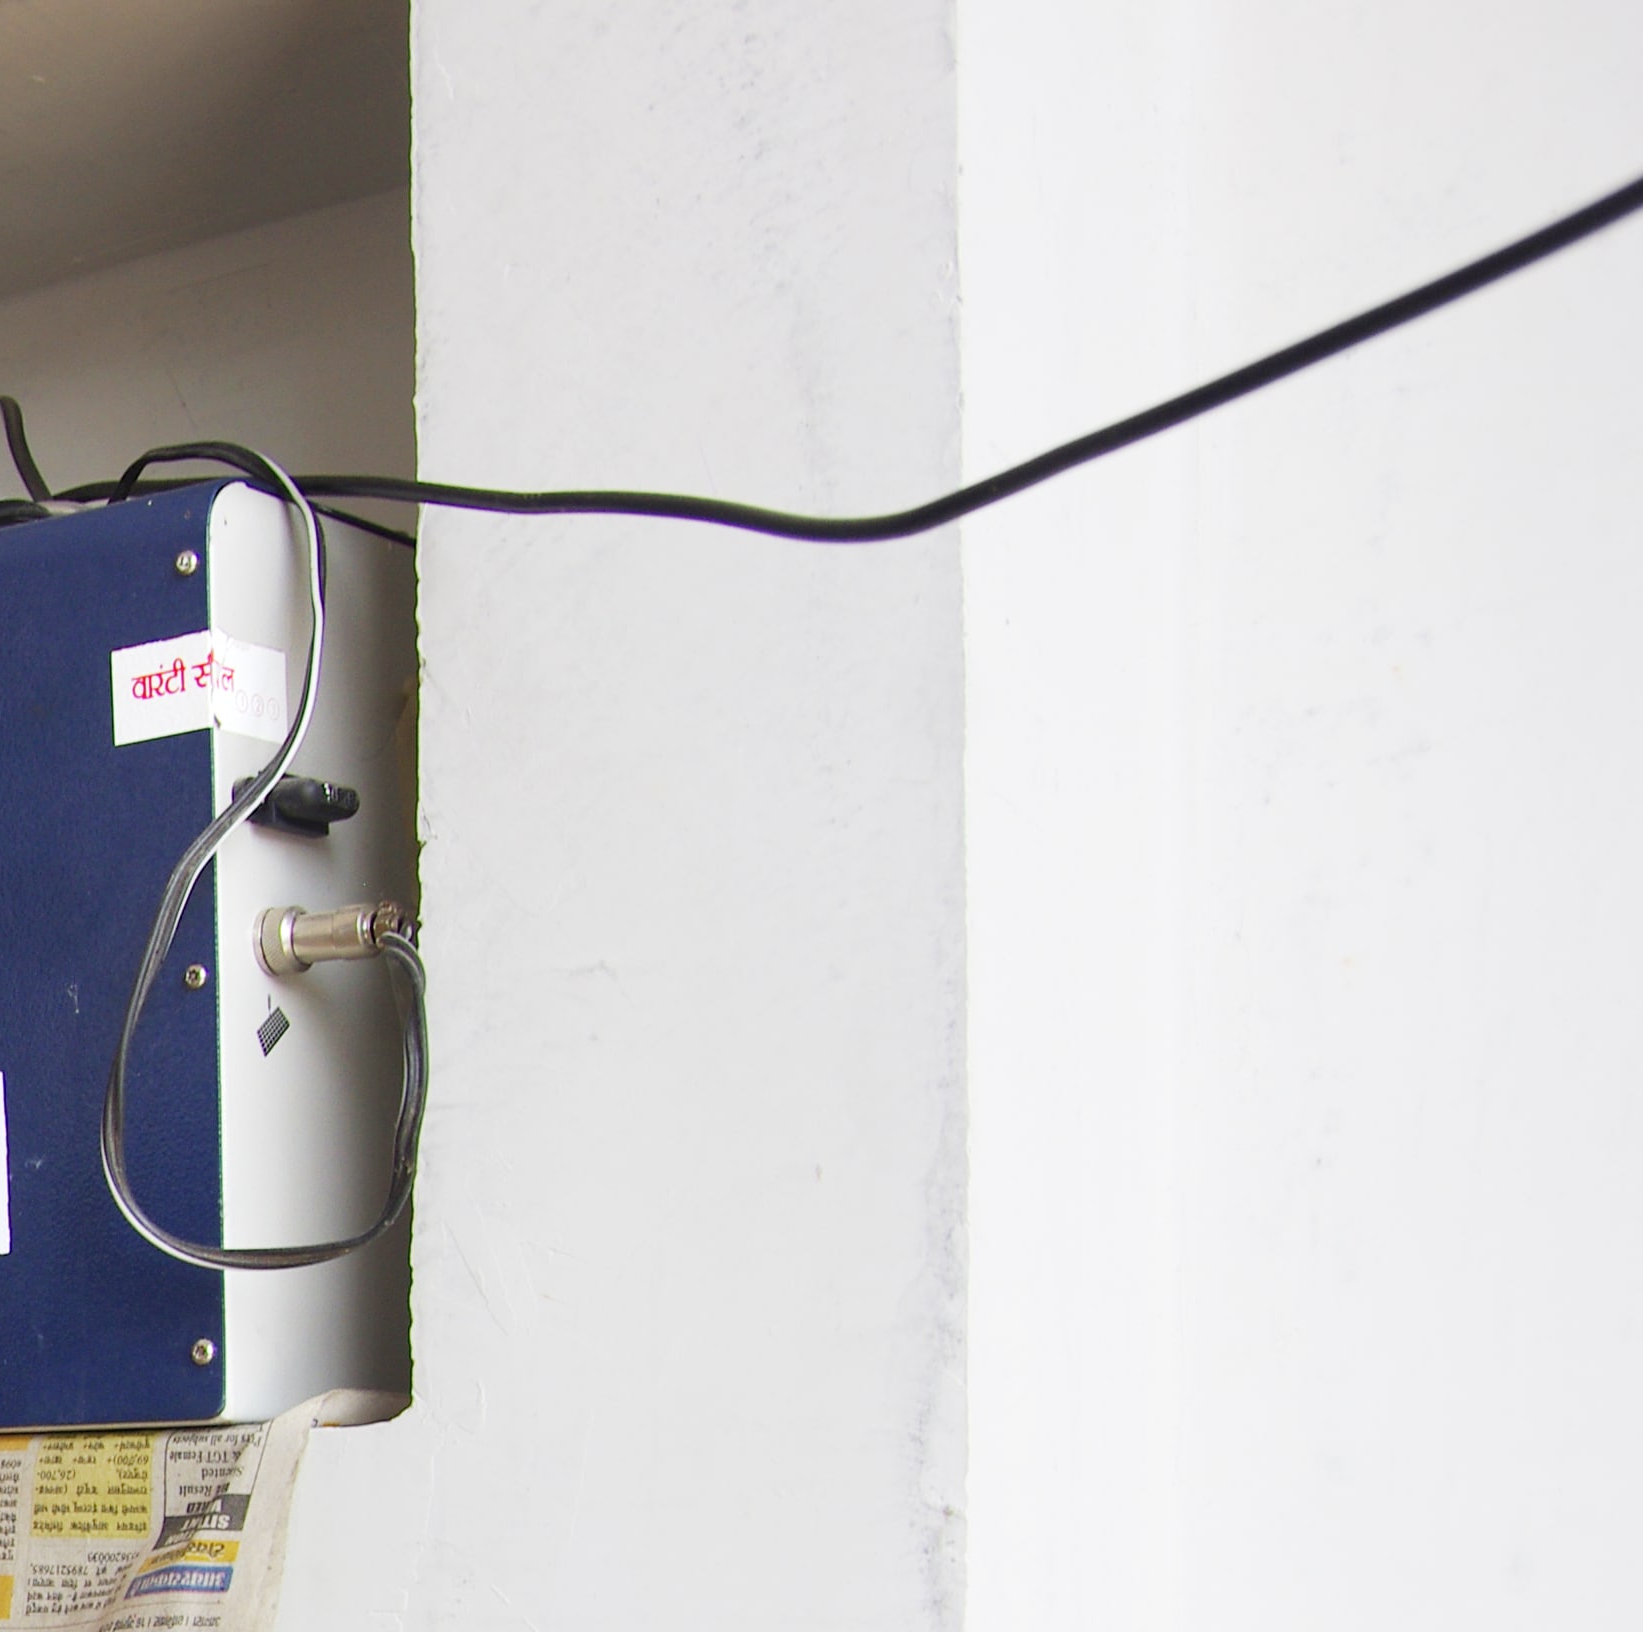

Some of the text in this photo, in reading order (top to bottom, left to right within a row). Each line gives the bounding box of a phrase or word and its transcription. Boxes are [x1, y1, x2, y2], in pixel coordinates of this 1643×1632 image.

[132, 658, 186, 700] वारंटी
[211, 1435, 223, 1446] all
[224, 1435, 238, 1446] for
[170, 1451, 202, 1462] Female
